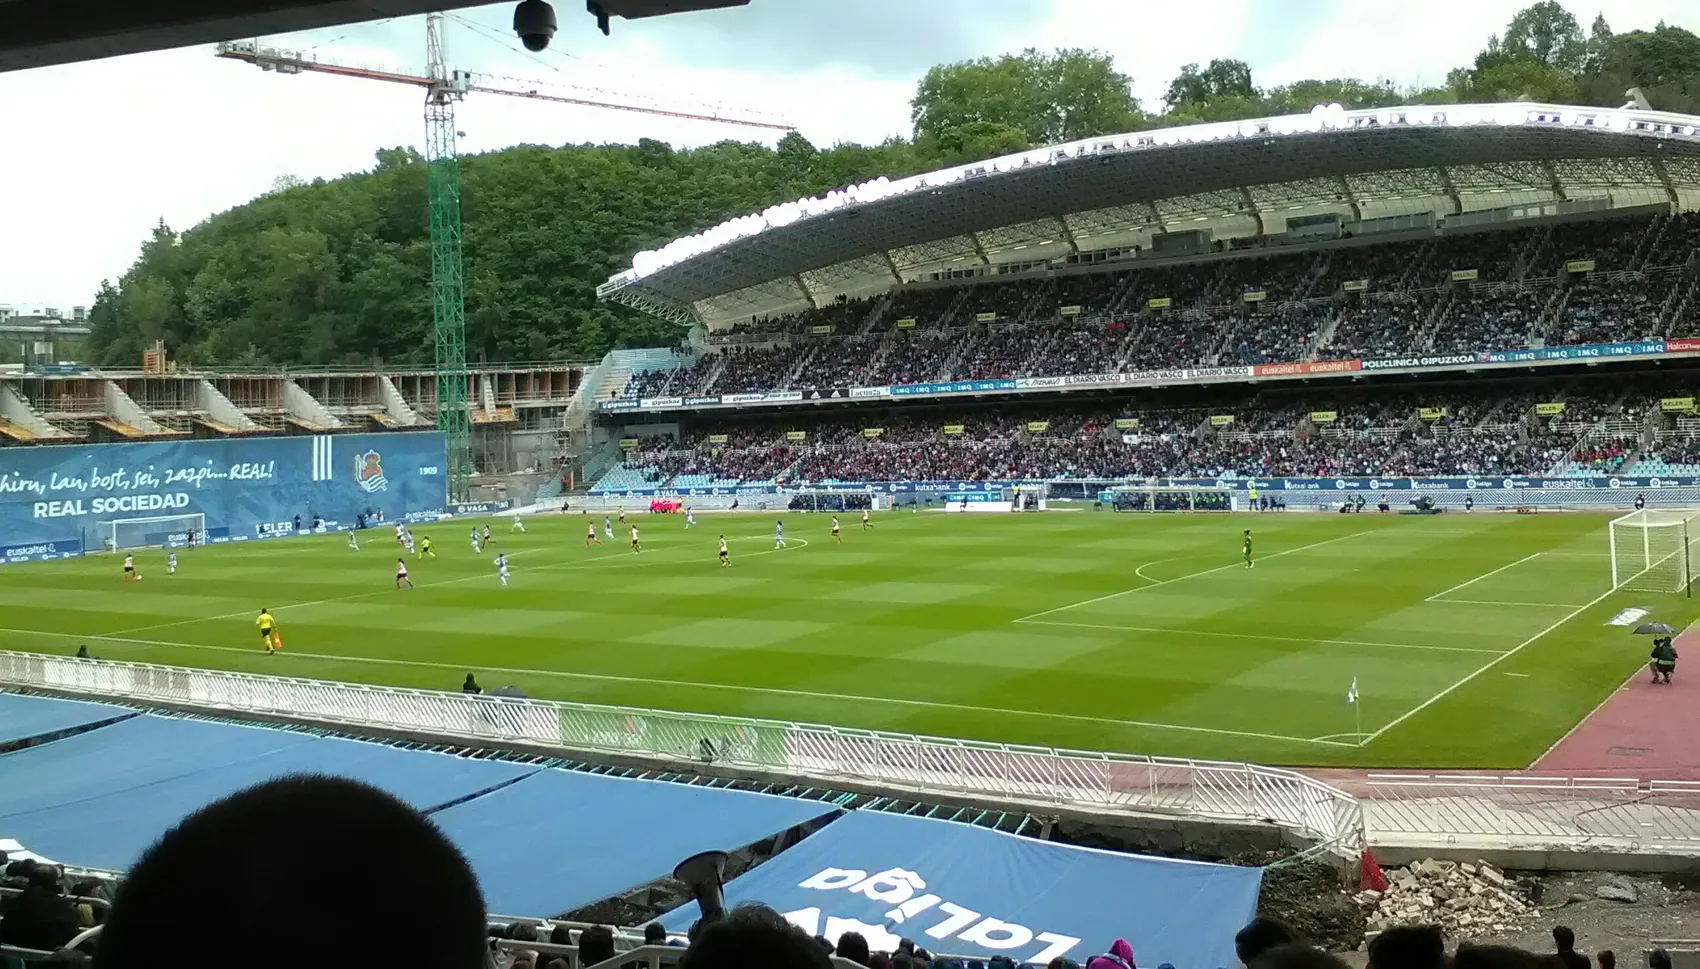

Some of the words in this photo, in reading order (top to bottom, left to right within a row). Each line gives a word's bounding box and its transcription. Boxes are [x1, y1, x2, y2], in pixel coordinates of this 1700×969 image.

[1642, 345, 1664, 353] IMQ
[1362, 359, 1419, 369] POLICLINICA
[1421, 355, 1475, 366] GIPUZKOA
[1187, 370, 1195, 378] EL
[1197, 368, 1222, 377] DIARIO
[1224, 367, 1249, 375] VASCO
[1262, 365, 1294, 375] euskaltel
[1310, 363, 1344, 372] euskaltel
[1098, 374, 1121, 382] VASCO
[1134, 372, 1159, 380] DIARIO
[1160, 371, 1183, 379] VASCO
[915, 385, 930, 393] IMQ
[980, 383, 995, 391] IMQ
[1000, 382, 1015, 390] IMQ
[418, 466, 438, 475] 1909
[91, 467, 129, 491] bost,
[132, 465, 160, 489] sei,
[1411, 479, 1449, 489] kutxabank
[1542, 478, 1586, 489] euskaltel
[34, 501, 87, 519] REAL
[92, 492, 190, 514] SOCIEDAD
[466, 504, 488, 512] VASA
[168, 531, 203, 542] euskel
[6, 544, 48, 557] euskaltel
